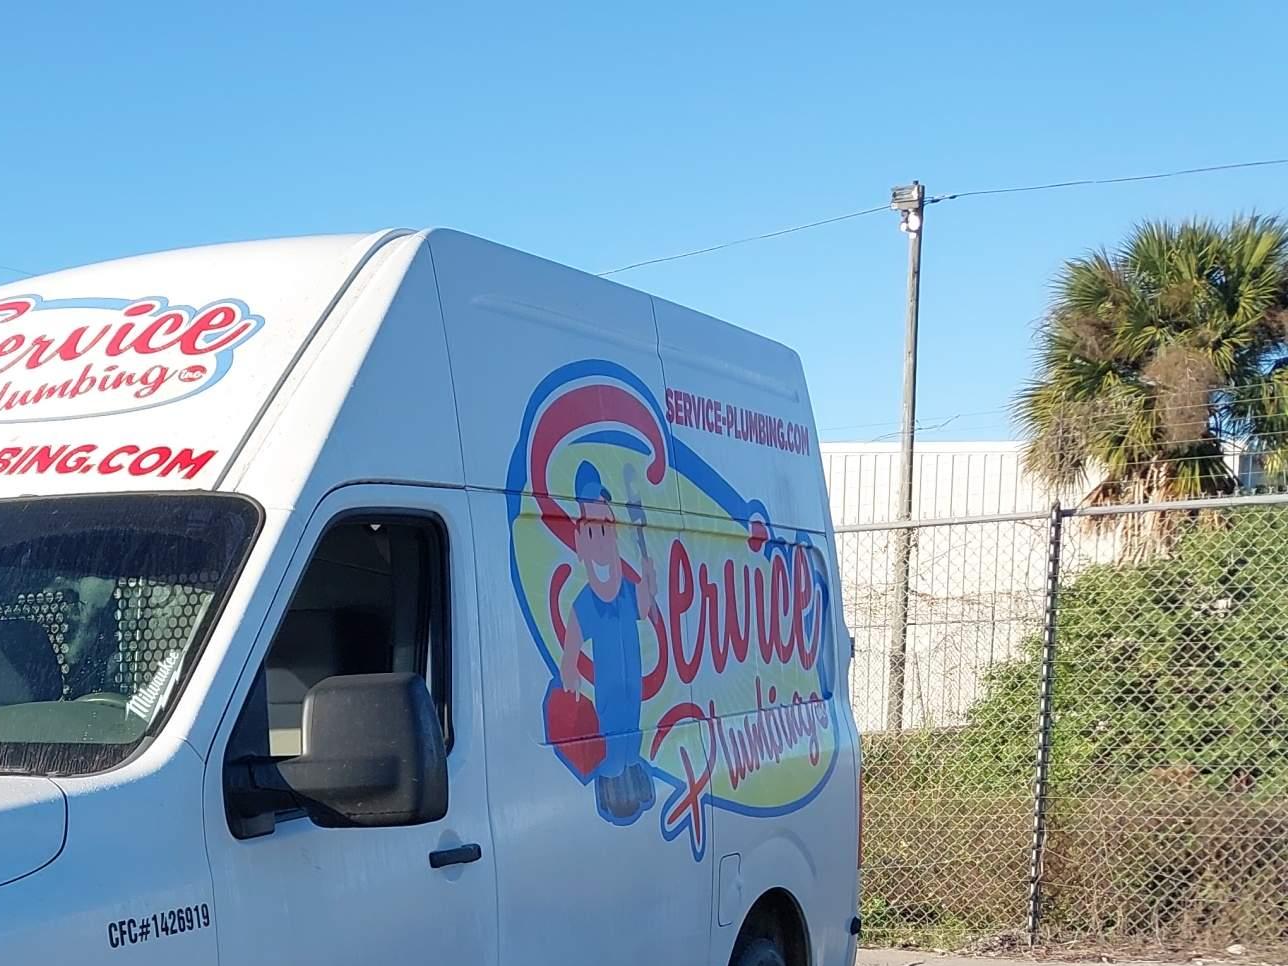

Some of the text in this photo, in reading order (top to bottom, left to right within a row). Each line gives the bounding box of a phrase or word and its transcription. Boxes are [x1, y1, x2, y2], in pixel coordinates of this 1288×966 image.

[665, 387, 810, 456] SERVICE-PLUMBING.COM
[531, 384, 821, 701] Service
[125, 648, 179, 720] Milwaukee
[650, 676, 820, 843] Plumbing
[108, 903, 210, 948] CFC#1426919
